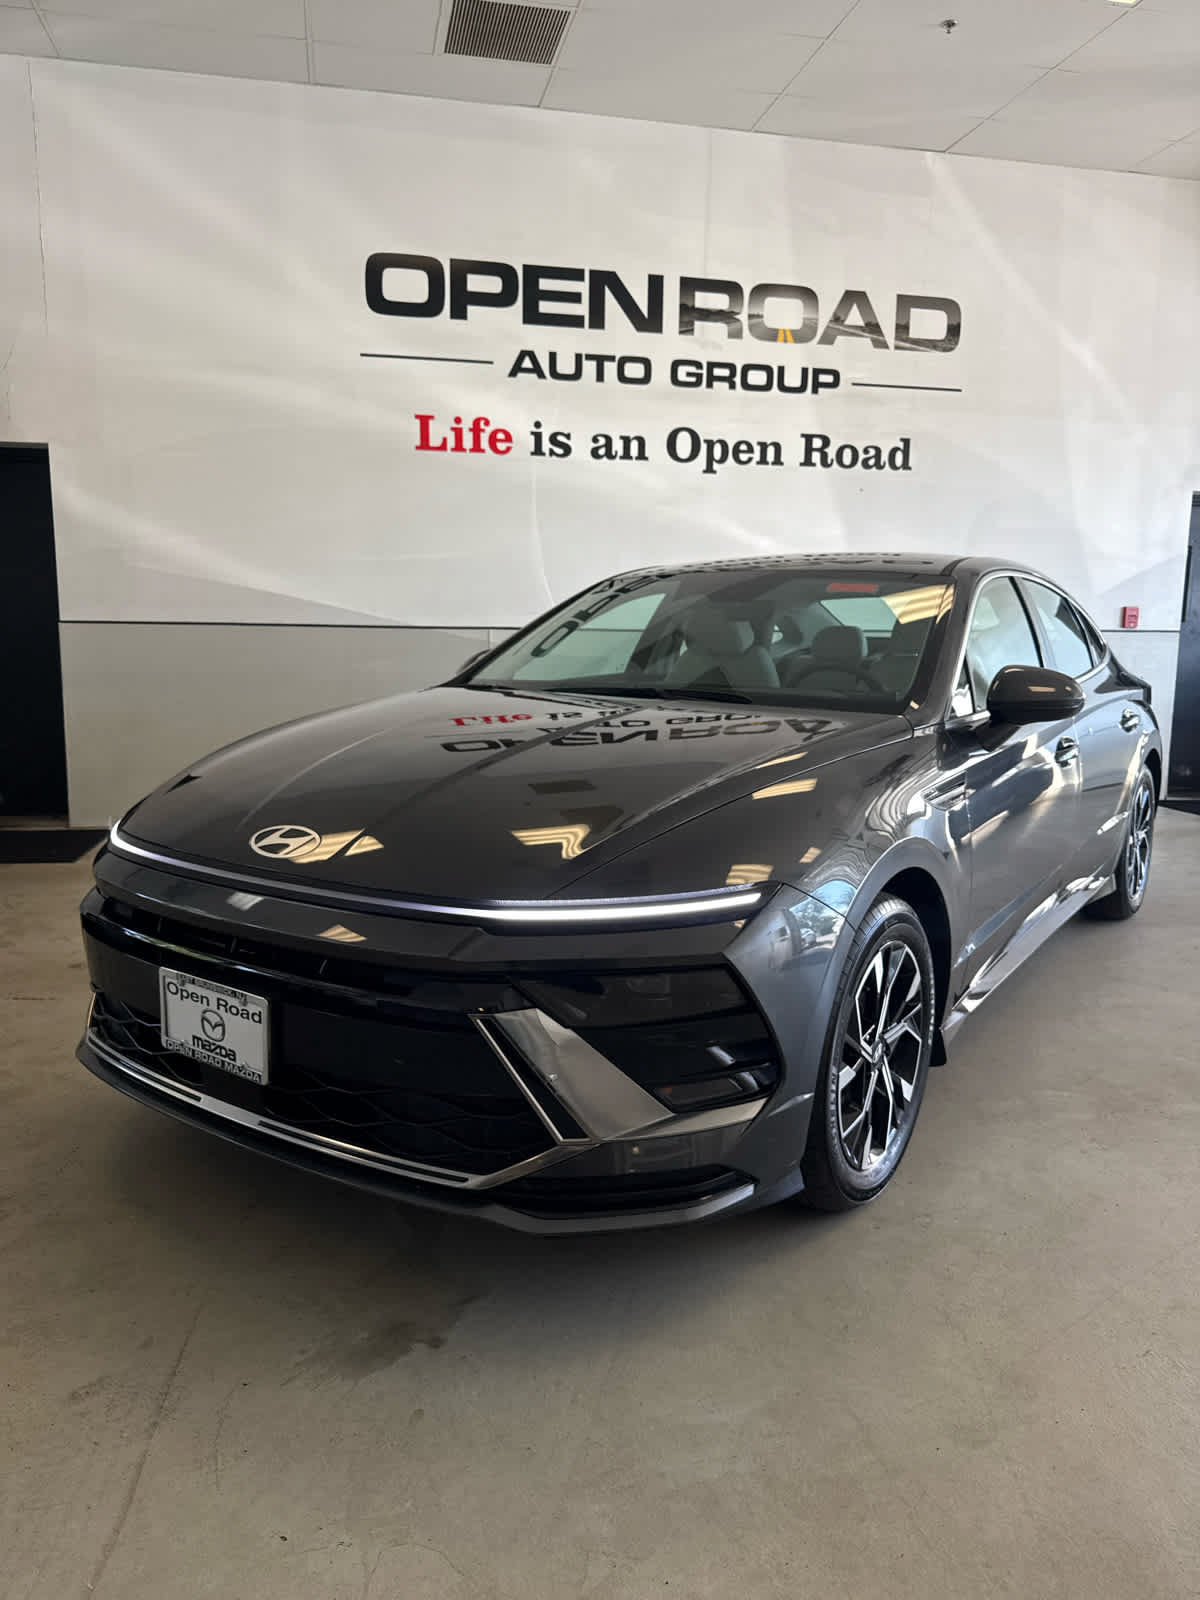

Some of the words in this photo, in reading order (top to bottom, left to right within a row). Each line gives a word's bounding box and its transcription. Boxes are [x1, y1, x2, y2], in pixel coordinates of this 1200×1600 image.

[365, 252, 665, 334] OPEN
[678, 275, 962, 353] ROAD
[508, 349, 652, 385] AUTO
[670, 359, 841, 395] GROUP
[414, 414, 513, 455] Life
[530, 421, 572, 458] is
[590, 433, 649, 461] an
[666, 426, 785, 475] Open
[799, 433, 912, 471] Road
[166, 981, 210, 1006] Open
[216, 997, 263, 1025] Road
[192, 1034, 237, 1062] mazda
